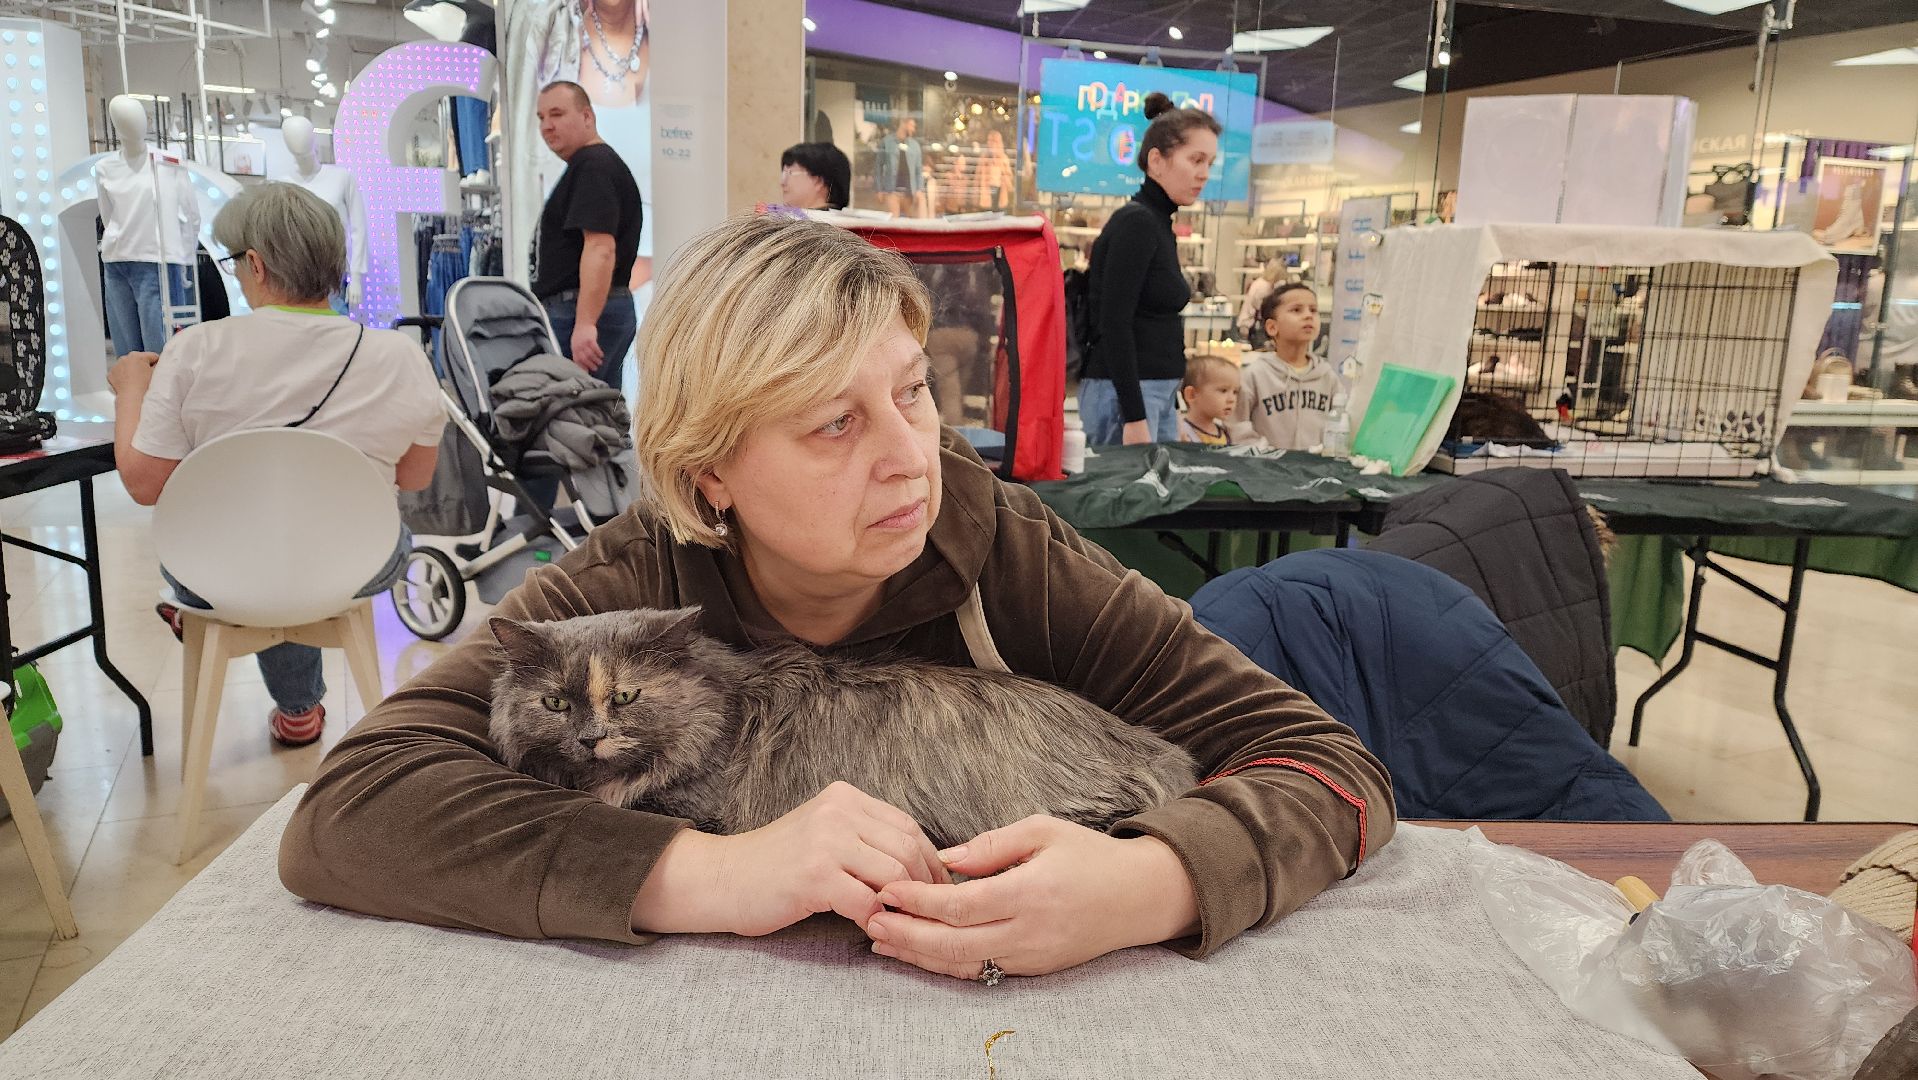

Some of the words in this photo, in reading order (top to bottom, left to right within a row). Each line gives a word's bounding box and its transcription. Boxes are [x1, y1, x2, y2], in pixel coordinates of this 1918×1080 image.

[1078, 82, 1152, 120] ПОДАРК
[660, 126, 693, 139] befree
[1696, 133, 1747, 153] СКАЯ
[662, 147, 691, 158] 10-22
